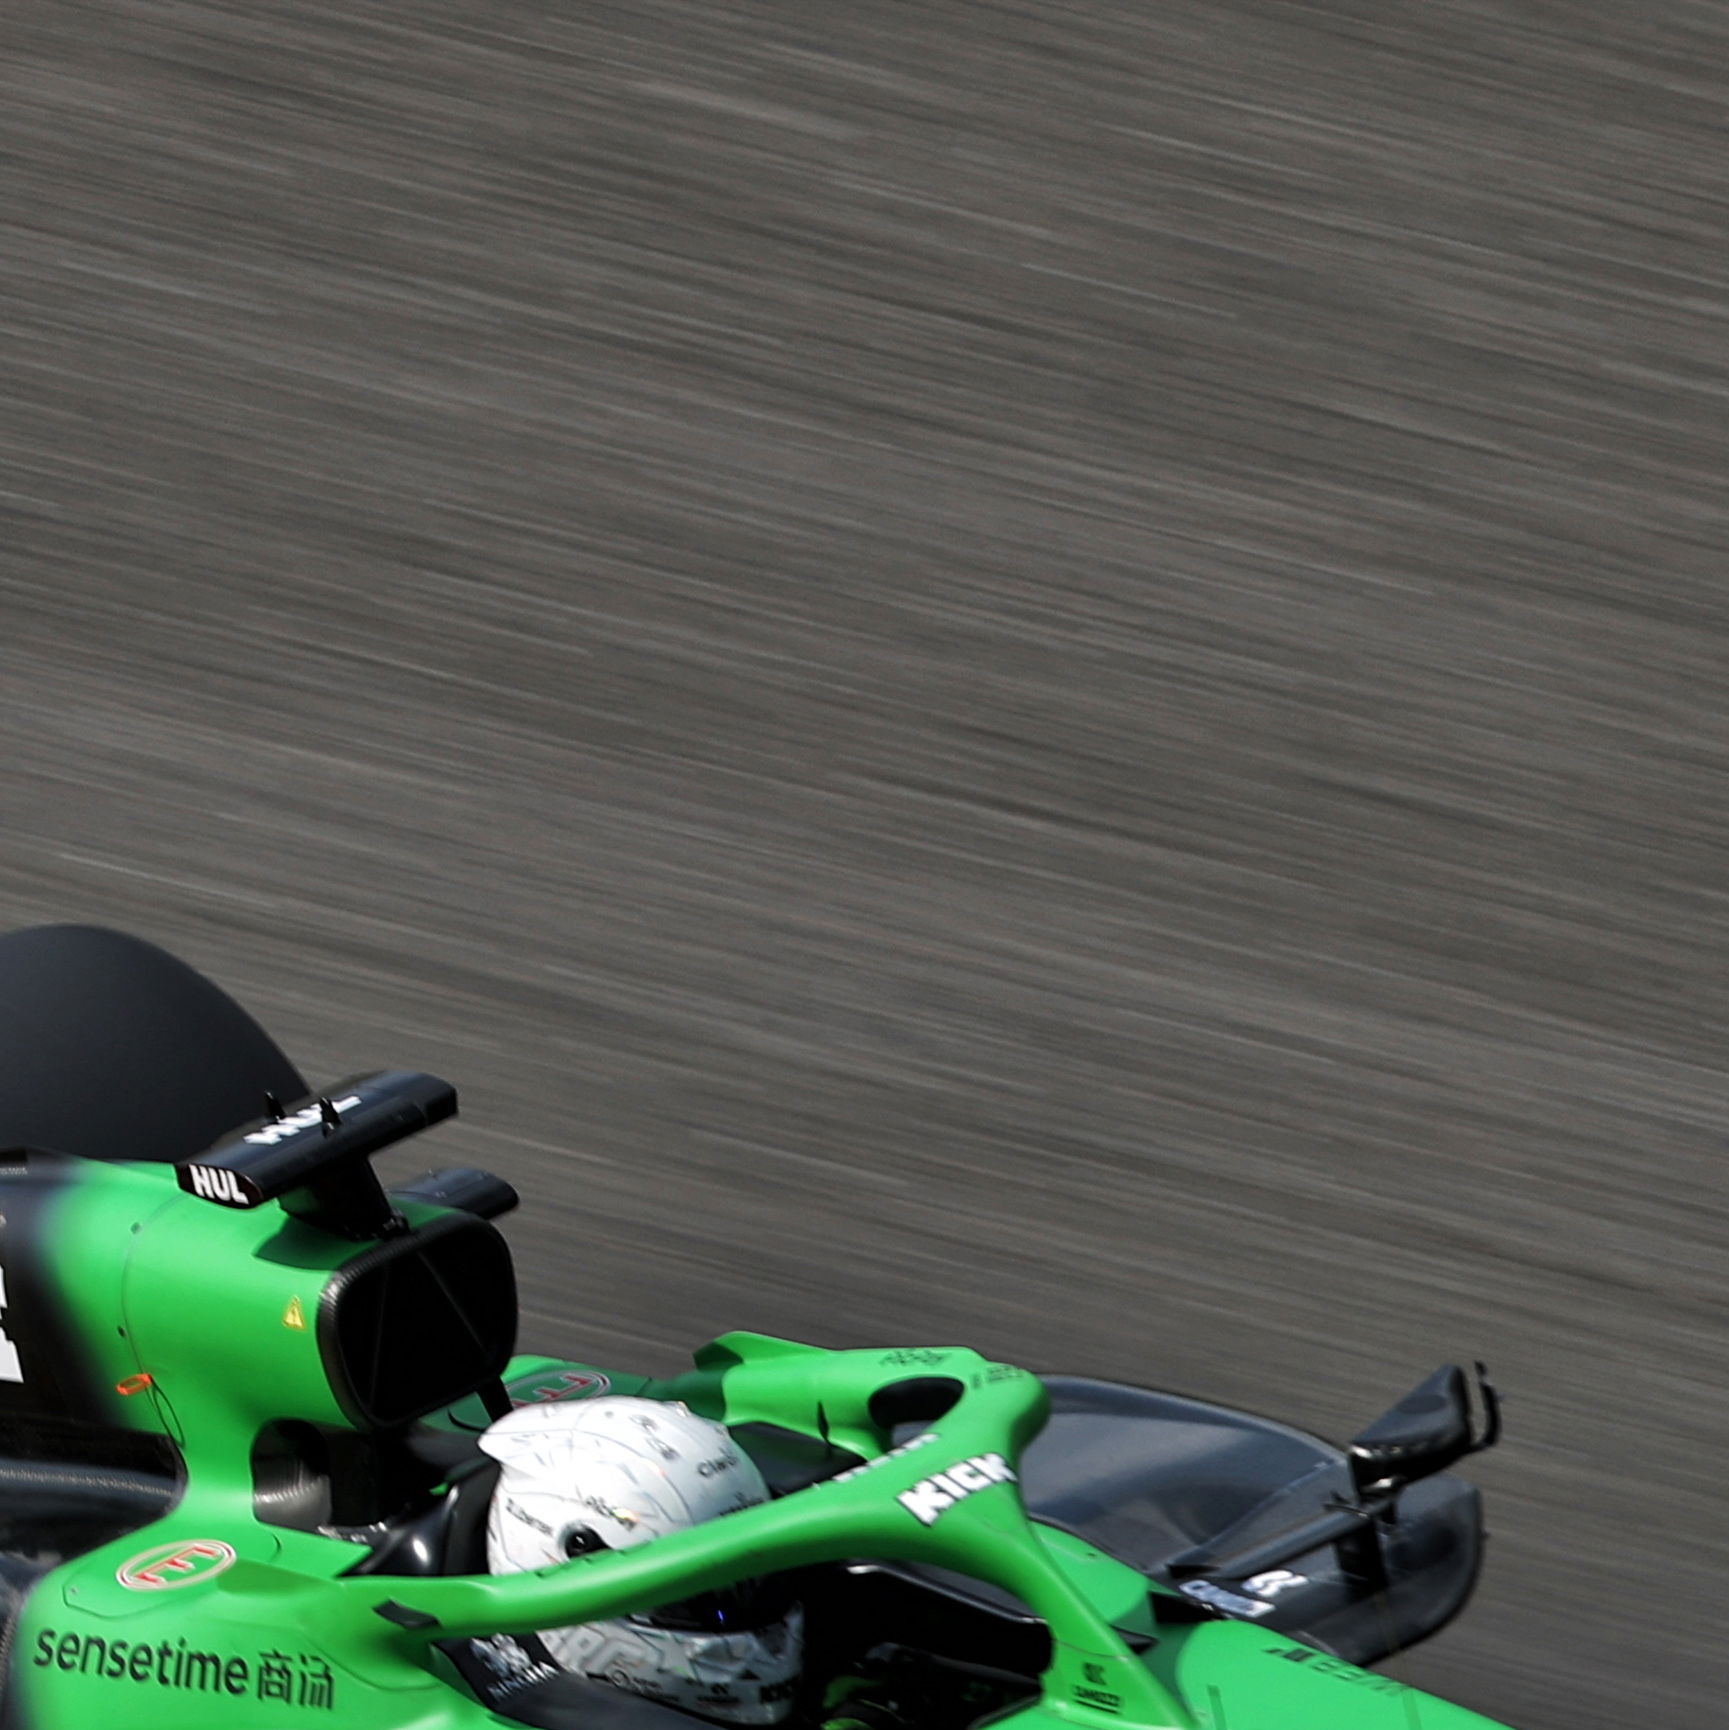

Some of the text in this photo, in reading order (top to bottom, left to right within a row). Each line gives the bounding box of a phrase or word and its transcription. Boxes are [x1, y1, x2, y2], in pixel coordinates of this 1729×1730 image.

[188, 1163, 250, 1205] HUL
[896, 1453, 1018, 1528] KICK
[33, 1627, 250, 1696] sensetime
[256, 1648, 335, 1711] 商汤
